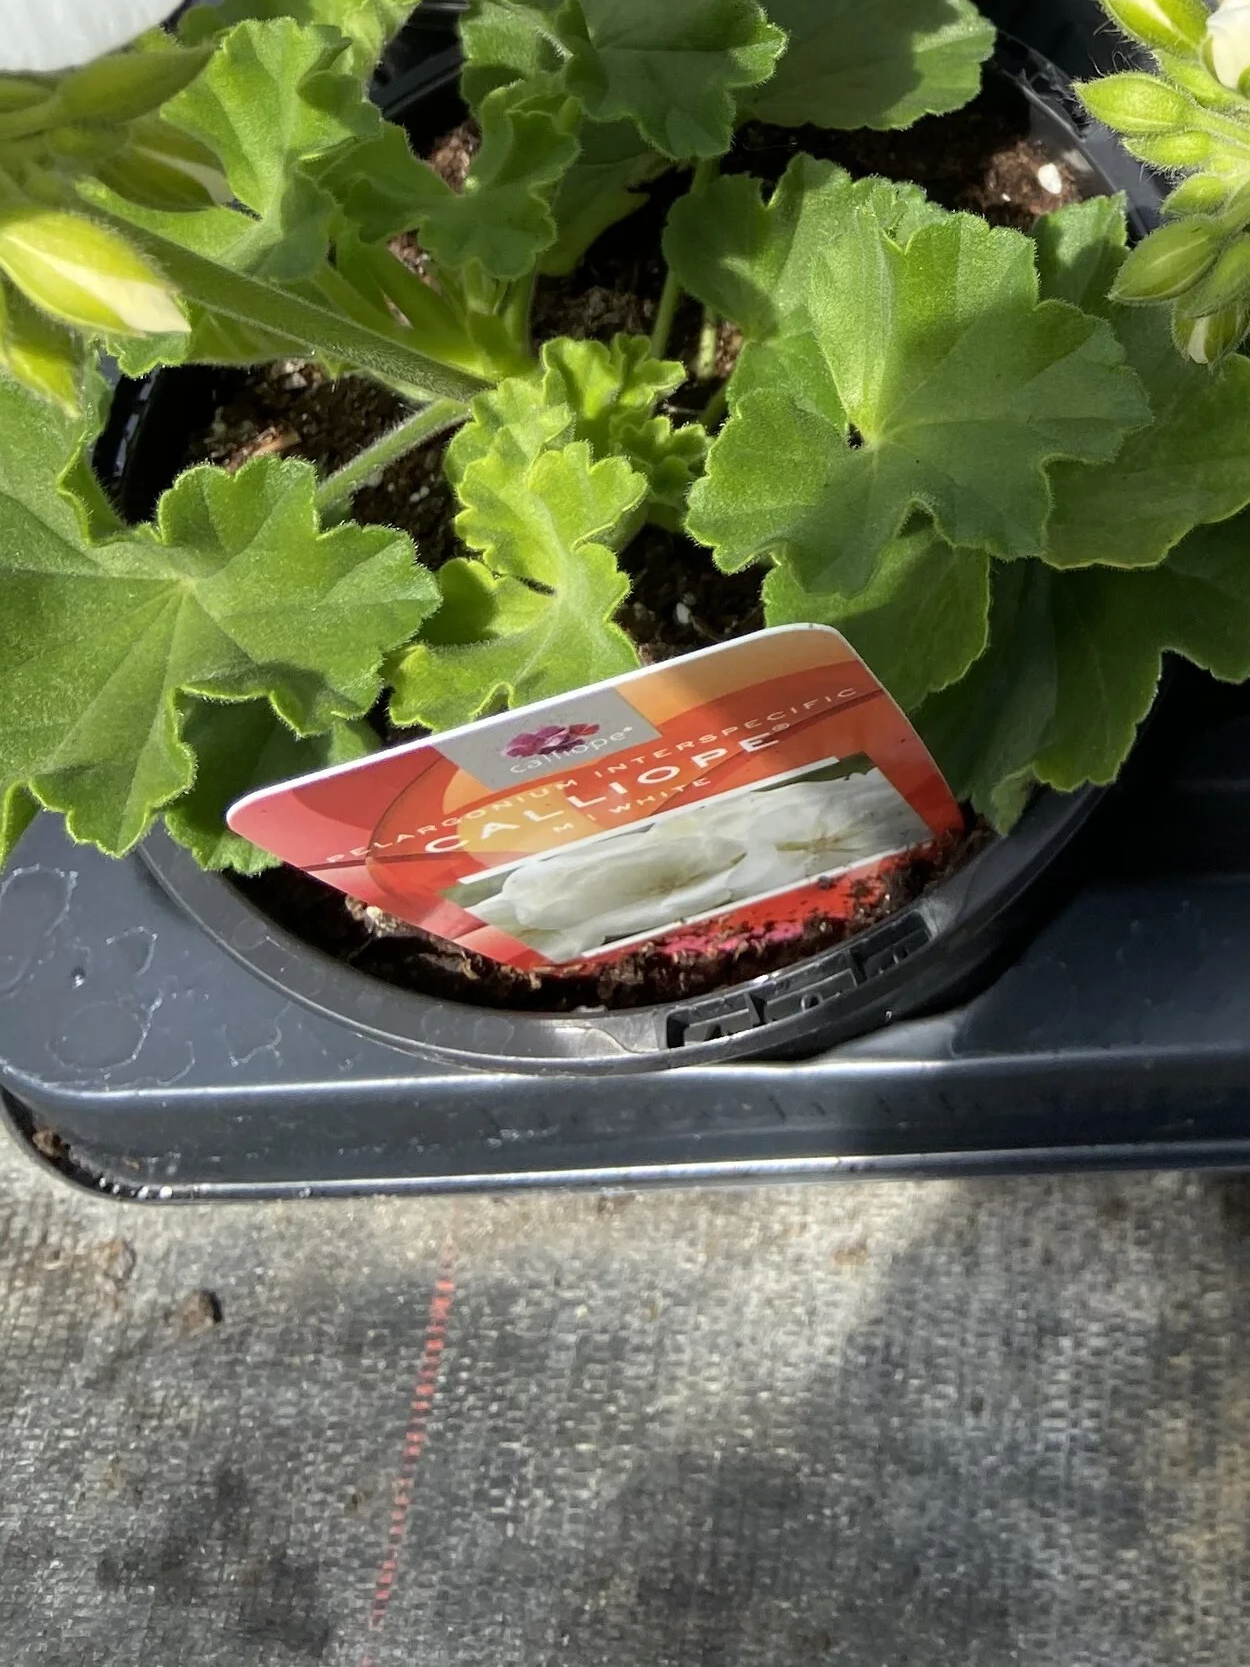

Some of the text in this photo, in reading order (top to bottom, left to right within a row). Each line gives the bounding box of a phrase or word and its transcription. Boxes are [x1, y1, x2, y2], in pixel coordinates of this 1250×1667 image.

[326, 687, 857, 863] PELARGONIUM INTERSPECIFIC
[552, 822, 575, 834] M
[607, 777, 711, 814] WHITE
